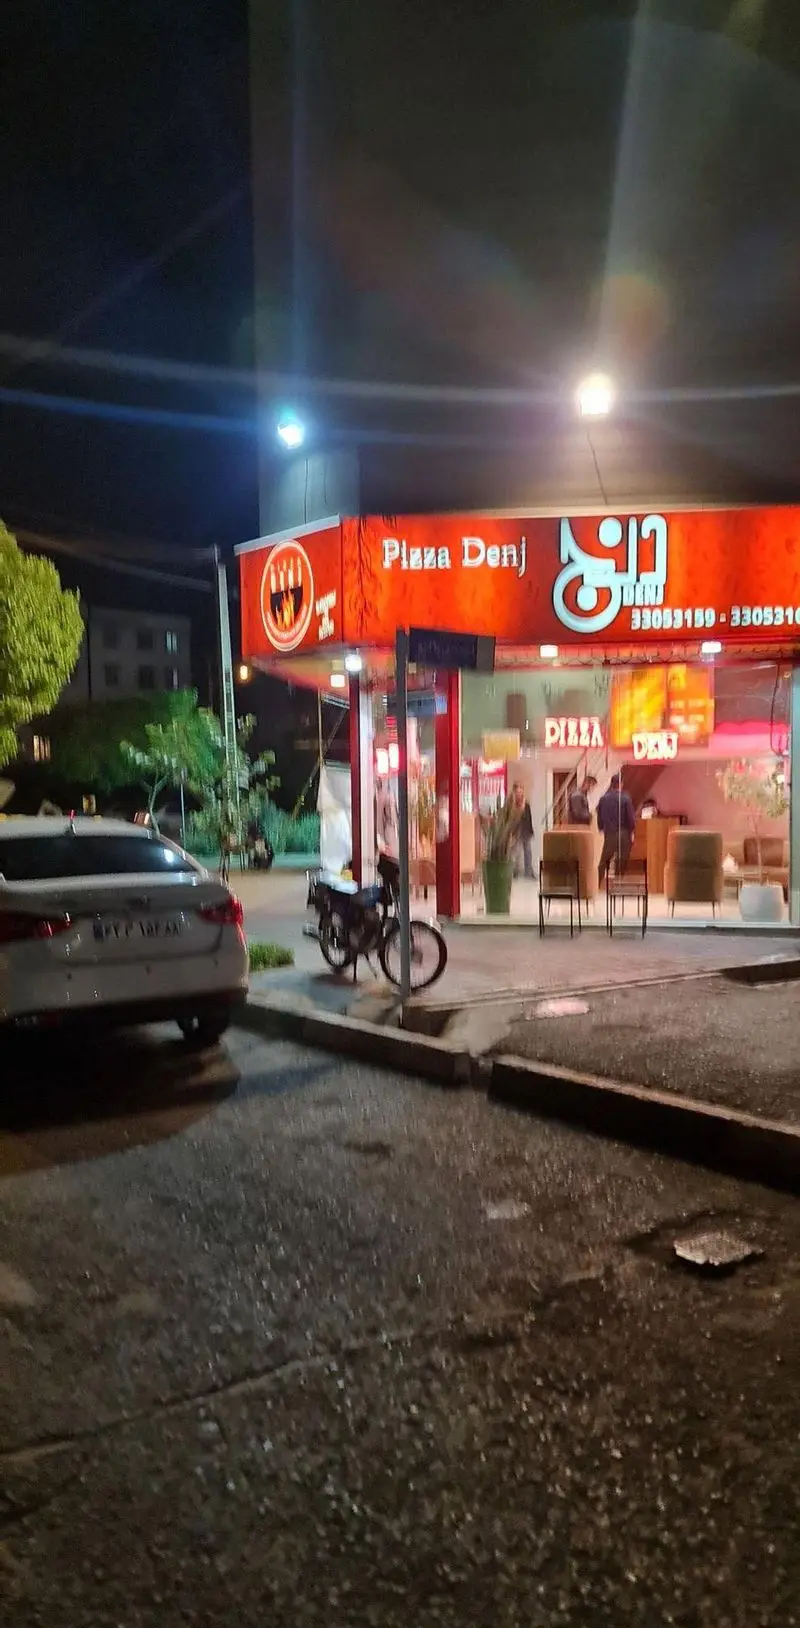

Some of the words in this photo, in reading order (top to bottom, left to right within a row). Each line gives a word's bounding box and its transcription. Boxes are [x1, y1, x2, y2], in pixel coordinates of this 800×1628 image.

[382, 537, 451, 570] Pizza
[461, 535, 526, 577] Denj
[623, 584, 664, 607] DENJ
[631, 608, 716, 631] 33053159
[545, 716, 604, 748] PIZZA
[632, 731, 679, 761] DENJ
